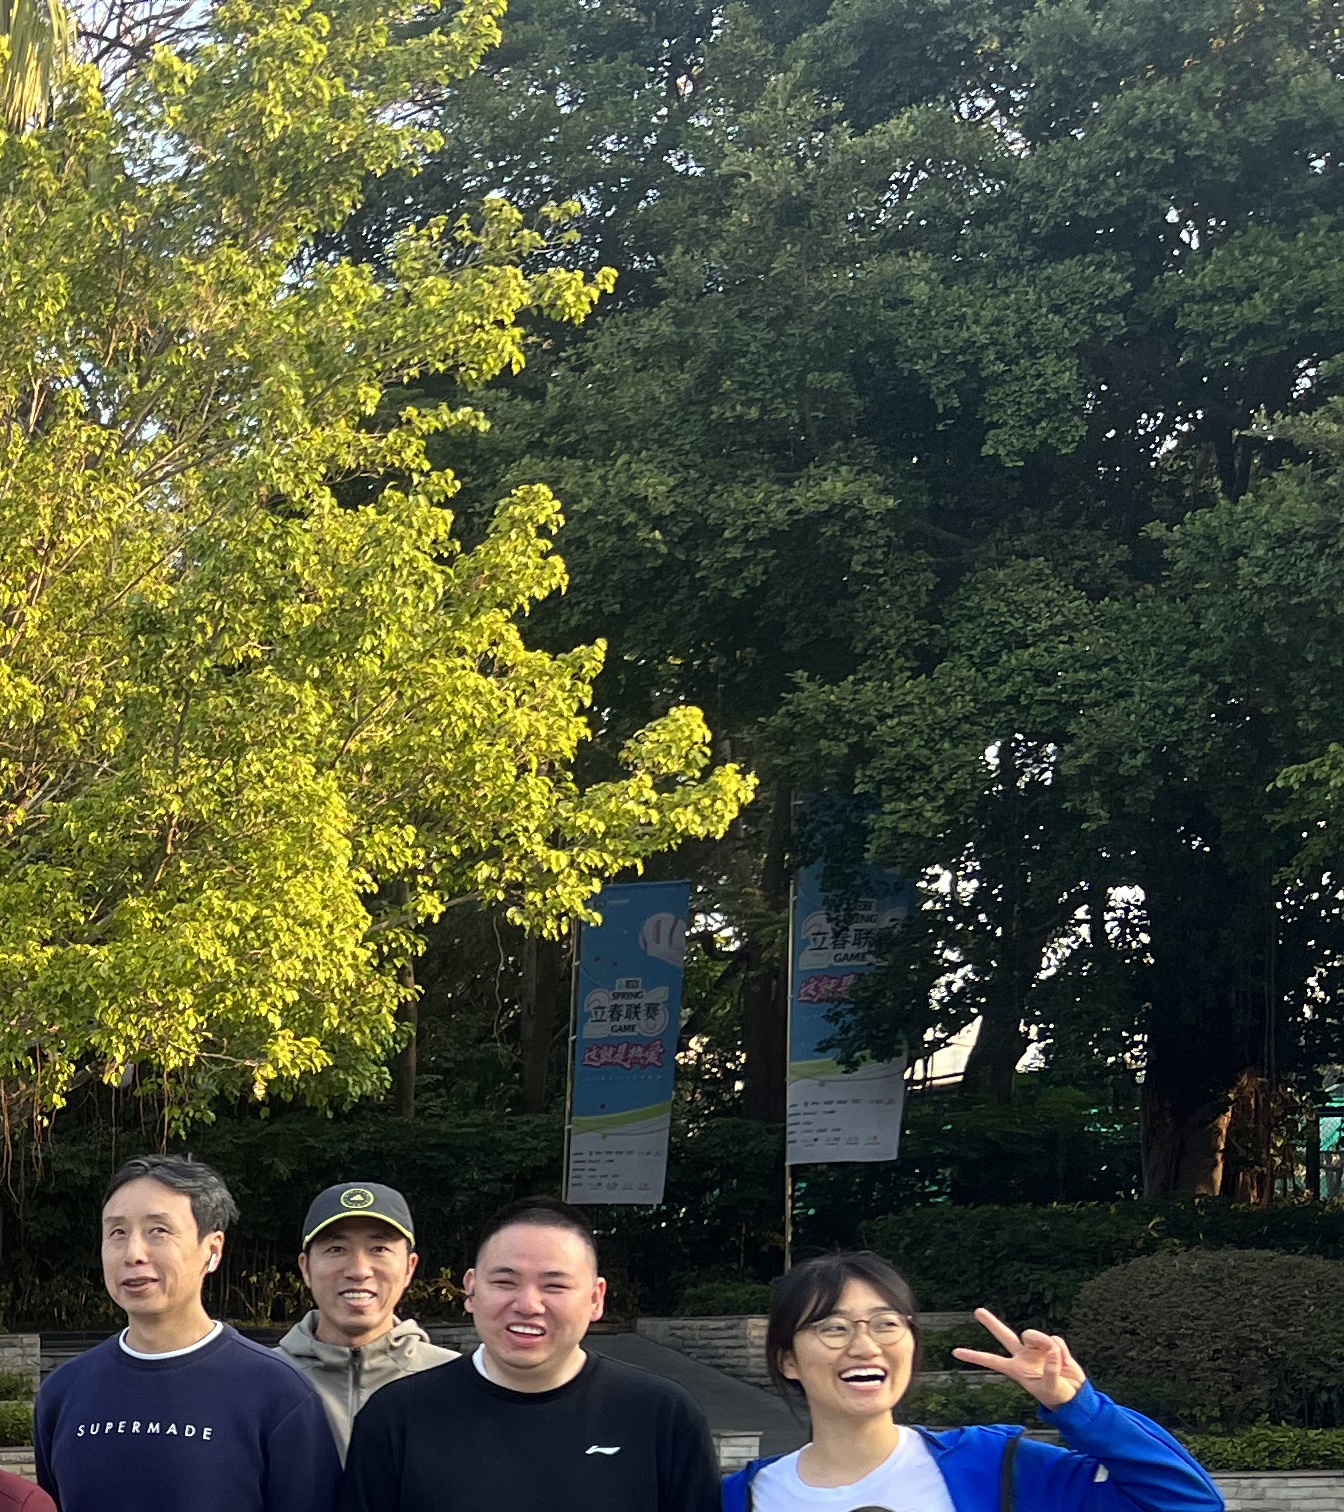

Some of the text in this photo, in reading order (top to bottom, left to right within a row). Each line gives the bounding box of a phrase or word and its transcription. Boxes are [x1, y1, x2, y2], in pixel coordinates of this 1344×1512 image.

[612, 990, 644, 1000] SPRING
[591, 1002, 661, 1023] 立春联赛
[610, 1024, 637, 1033] GAME
[76, 1420, 213, 1441] SUPERMADE
